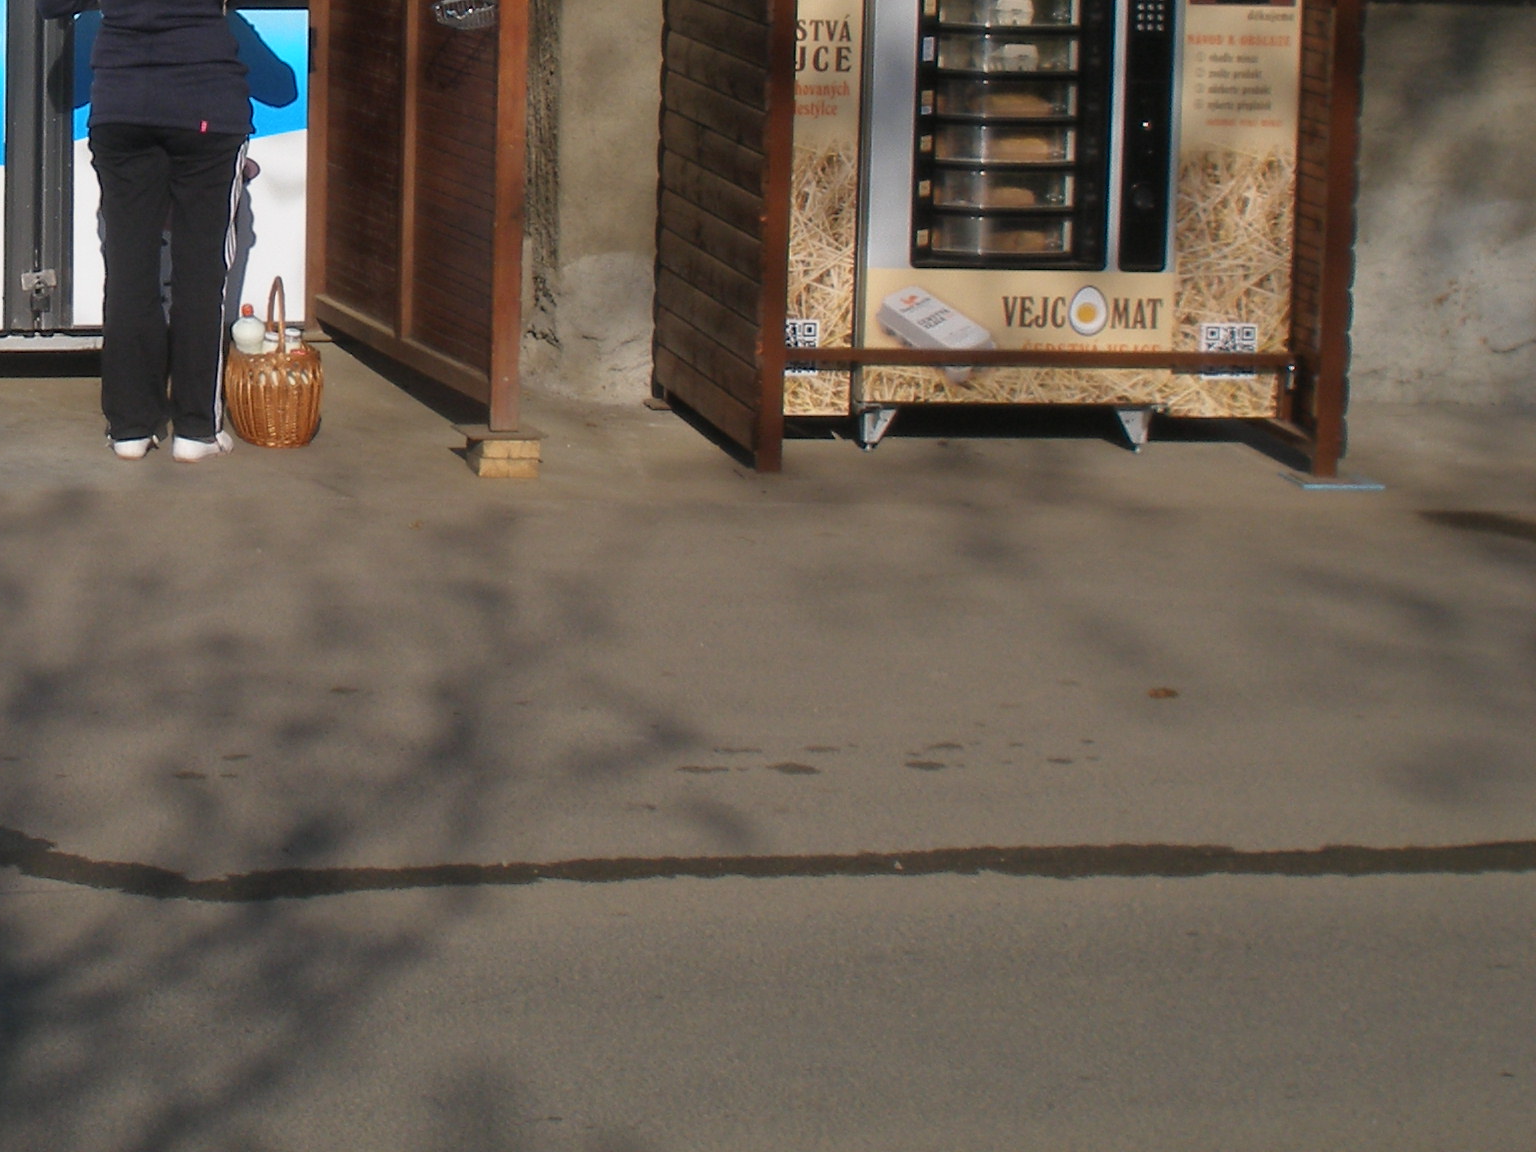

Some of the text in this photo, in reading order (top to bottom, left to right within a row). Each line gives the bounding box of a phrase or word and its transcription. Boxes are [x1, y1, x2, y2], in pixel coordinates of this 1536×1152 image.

[794, 14, 852, 42] STVÁ
[794, 46, 852, 72] JCE
[795, 81, 850, 99] hovaných
